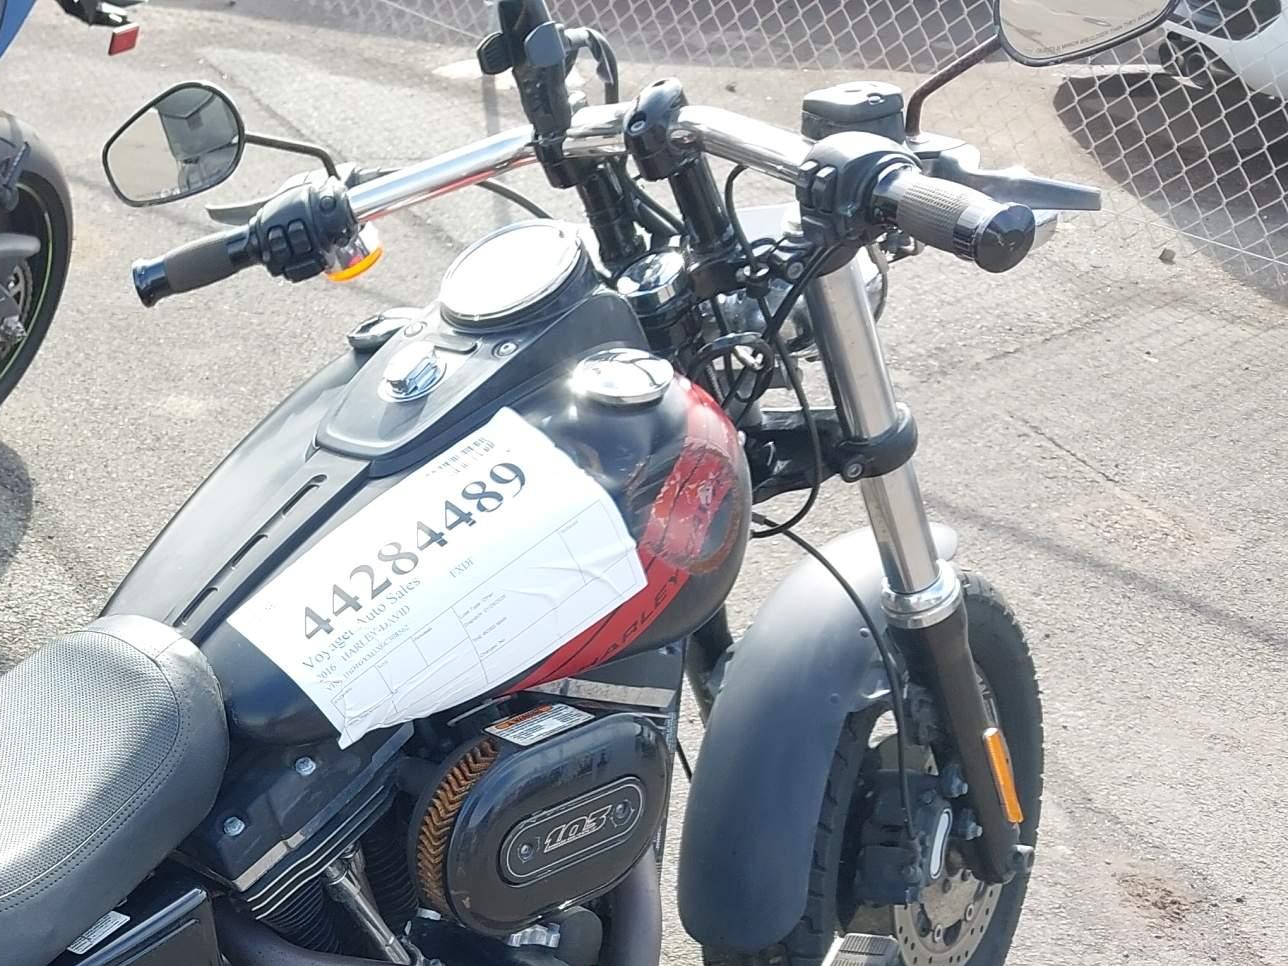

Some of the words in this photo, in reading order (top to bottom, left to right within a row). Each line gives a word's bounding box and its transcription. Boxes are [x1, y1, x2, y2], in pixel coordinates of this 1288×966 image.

[304, 462, 526, 640] 44284489
[301, 629, 355, 669] Voyager
[356, 603, 388, 626] Auto
[385, 577, 422, 602] Sales
[317, 664, 339, 680] 2016
[340, 604, 411, 664] HARLEY-DAVID
[543, 804, 613, 854] 103
